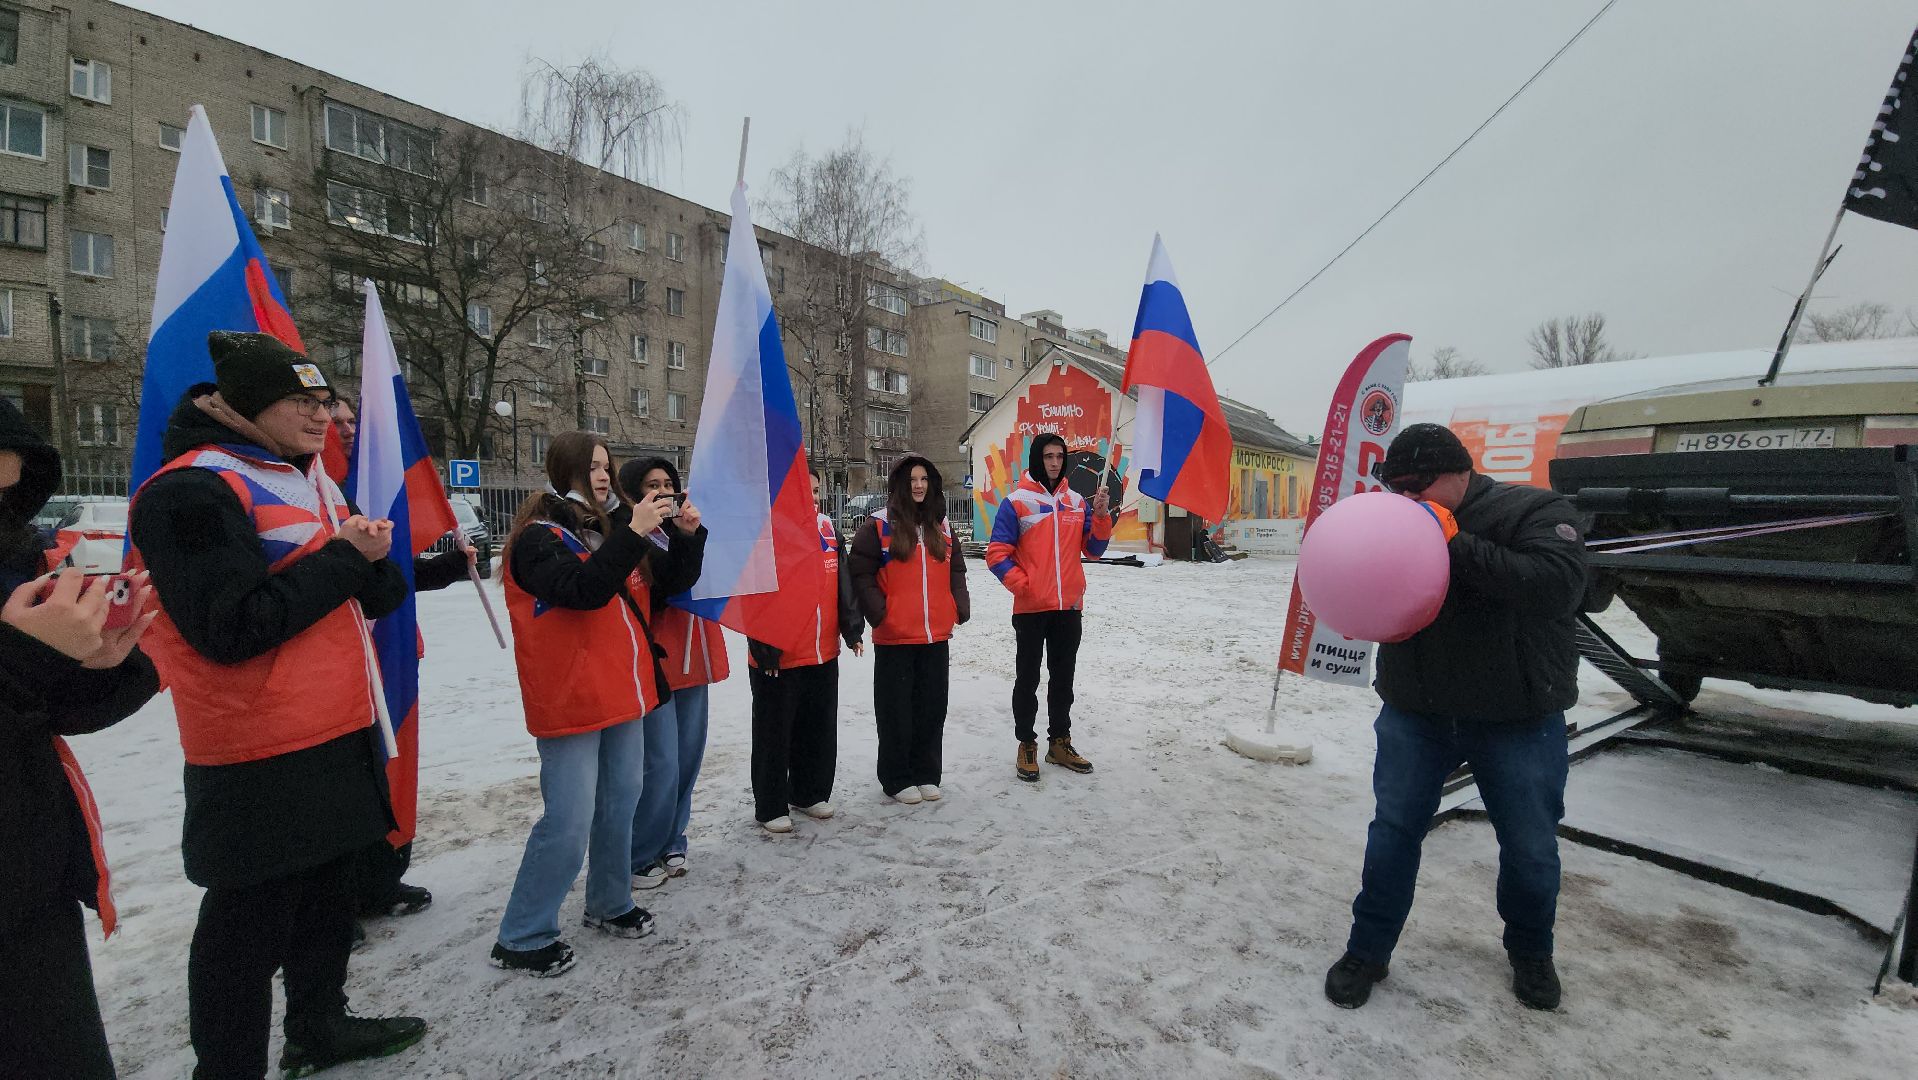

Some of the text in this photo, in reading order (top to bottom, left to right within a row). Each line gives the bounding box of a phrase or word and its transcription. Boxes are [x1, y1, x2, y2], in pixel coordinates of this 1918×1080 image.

[1322, 403, 1348, 482] 215-21-21
[1799, 428, 1825, 442] 77
[1236, 449, 1285, 472] МОТОКРОСС
[456, 463, 474, 484] P
[1315, 643, 1367, 662] пицца
[1311, 659, 1361, 675] и суши
